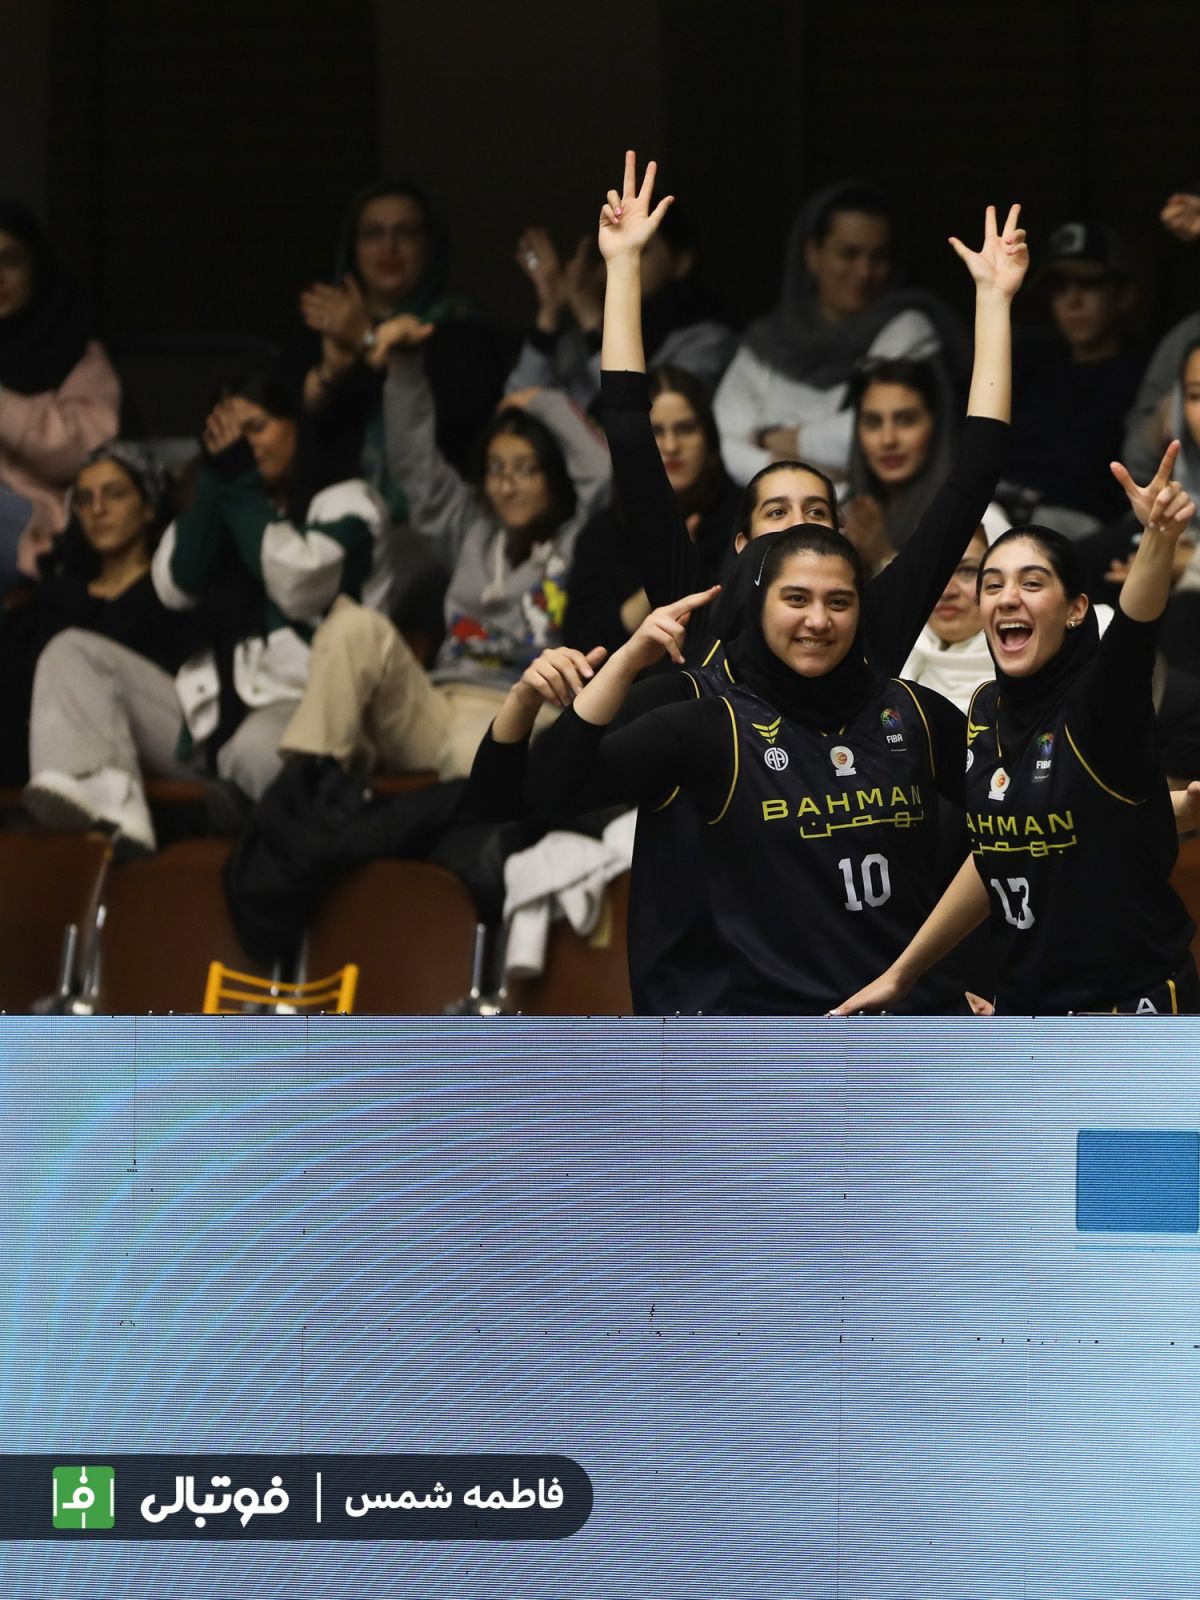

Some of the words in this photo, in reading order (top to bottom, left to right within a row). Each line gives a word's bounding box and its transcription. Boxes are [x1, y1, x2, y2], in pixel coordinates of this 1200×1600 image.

[886, 733, 903, 744] FIBA
[762, 785, 922, 821] BAHMAN
[966, 810, 1074, 836] AHMAN
[838, 853, 891, 911] 10
[990, 877, 1035, 929] 13
[1135, 997, 1158, 1014] A
